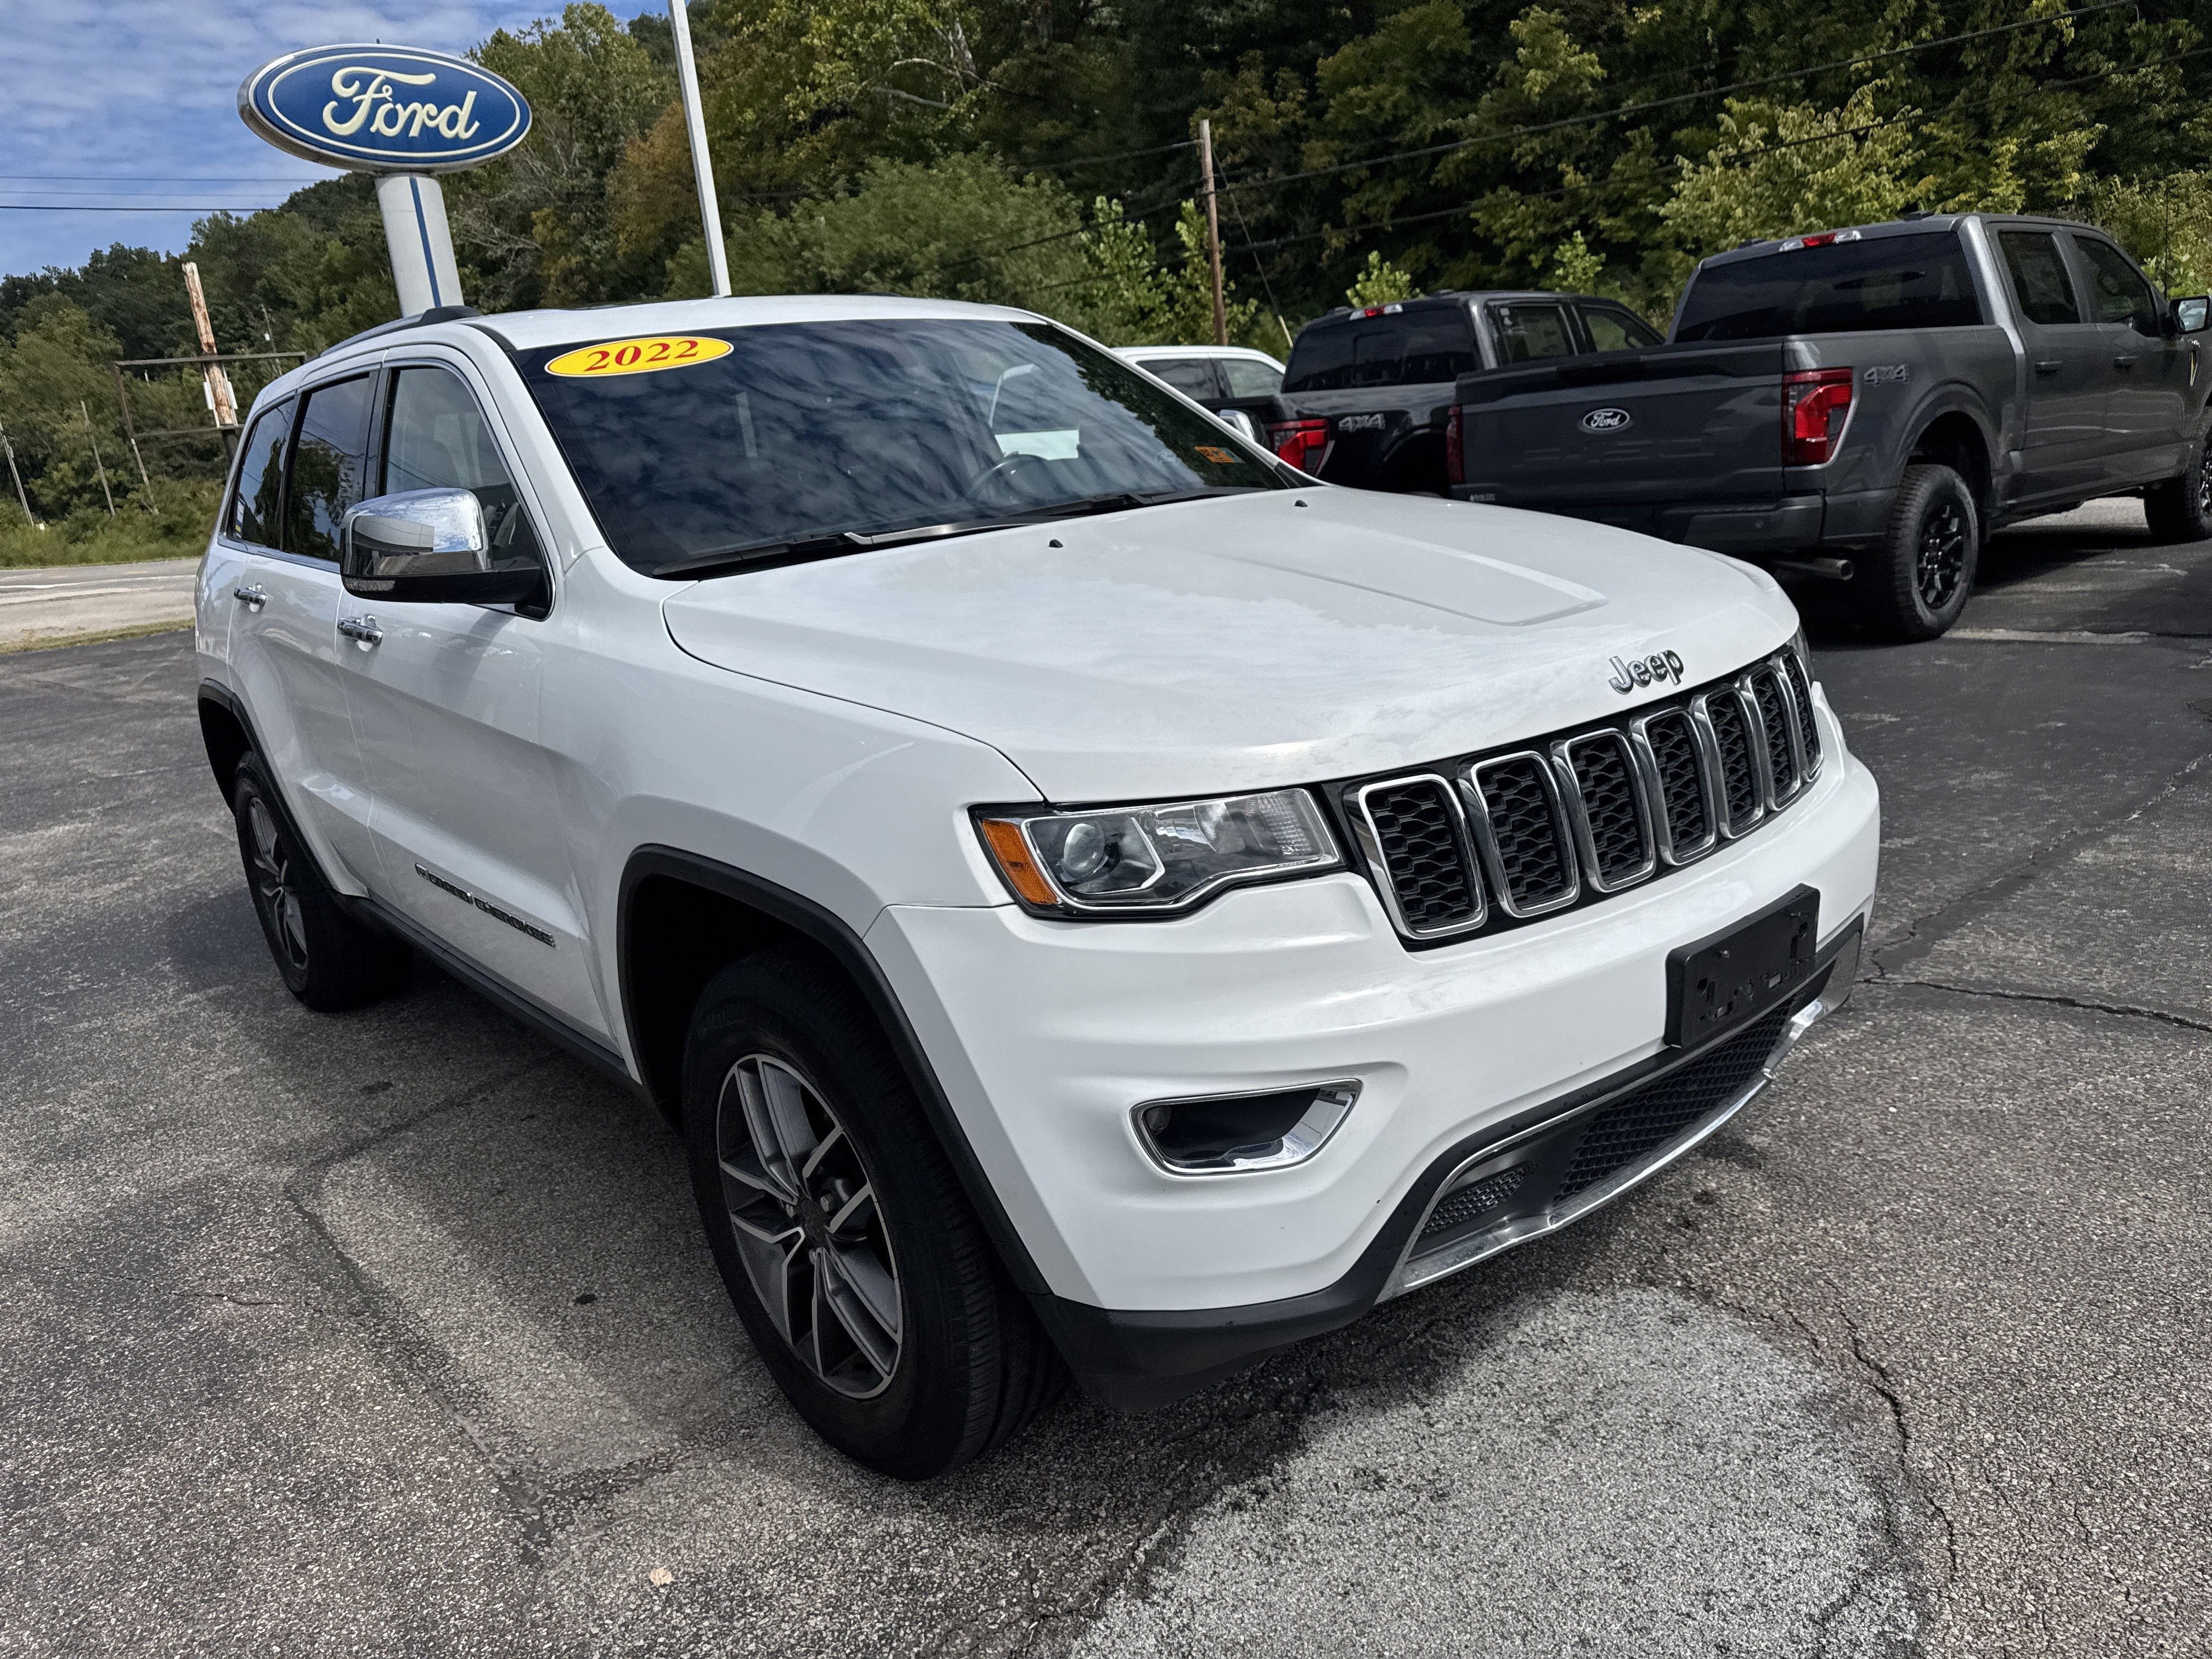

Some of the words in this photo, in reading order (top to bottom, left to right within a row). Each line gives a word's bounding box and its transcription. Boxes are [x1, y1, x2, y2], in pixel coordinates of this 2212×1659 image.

[323, 66, 480, 139] Ford
[583, 340, 699, 372] 2022
[1591, 412, 1621, 427] Ford
[1609, 650, 1684, 695] Jeep
[415, 863, 473, 904] GRAND
[474, 896, 556, 949] CHEROKEE
